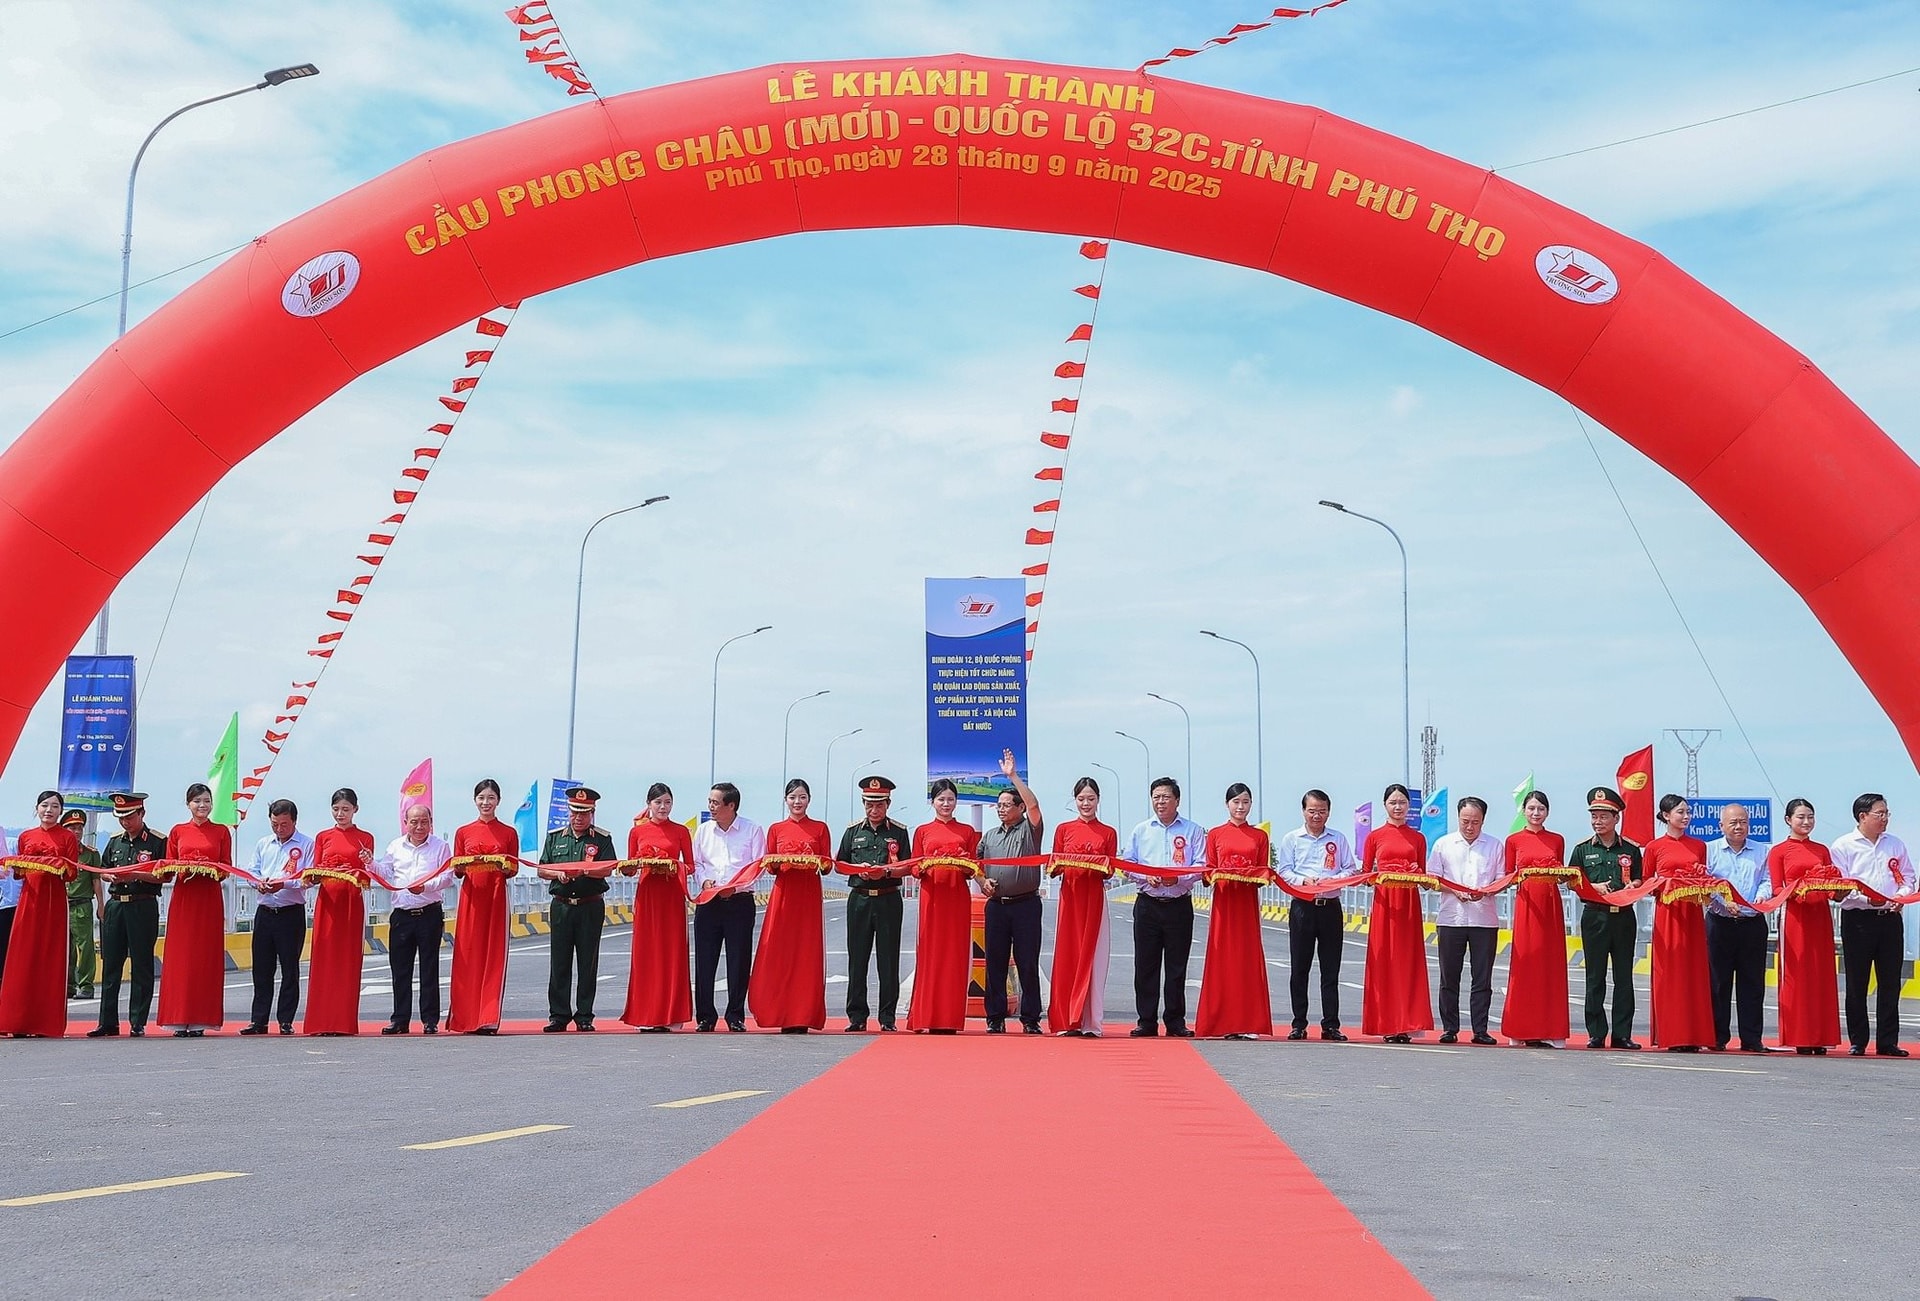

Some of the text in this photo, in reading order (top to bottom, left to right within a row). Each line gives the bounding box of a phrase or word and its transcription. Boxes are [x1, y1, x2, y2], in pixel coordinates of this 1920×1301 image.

[767, 66, 1156, 115] LỄ KHÁNH THÀNH
[404, 203, 490, 256] CẦU
[497, 150, 647, 218] PHONG
[655, 125, 772, 171] CHÂU
[784, 101, 900, 150] (MỚI)
[908, 117, 924, 125] -
[933, 99, 1050, 138] QUỐC
[1063, 110, 1116, 150] LỘ
[1327, 168, 1420, 221] PHÚ
[1426, 202, 1506, 262] THỌ
[705, 161, 763, 191] Phú
[912, 145, 948, 166] 28
[957, 145, 1040, 175] tháng
[1048, 155, 1066, 176] 9
[1075, 158, 1139, 185] năm
[1149, 166, 1222, 199] 2025
[1747, 825, 1769, 836] L32C
